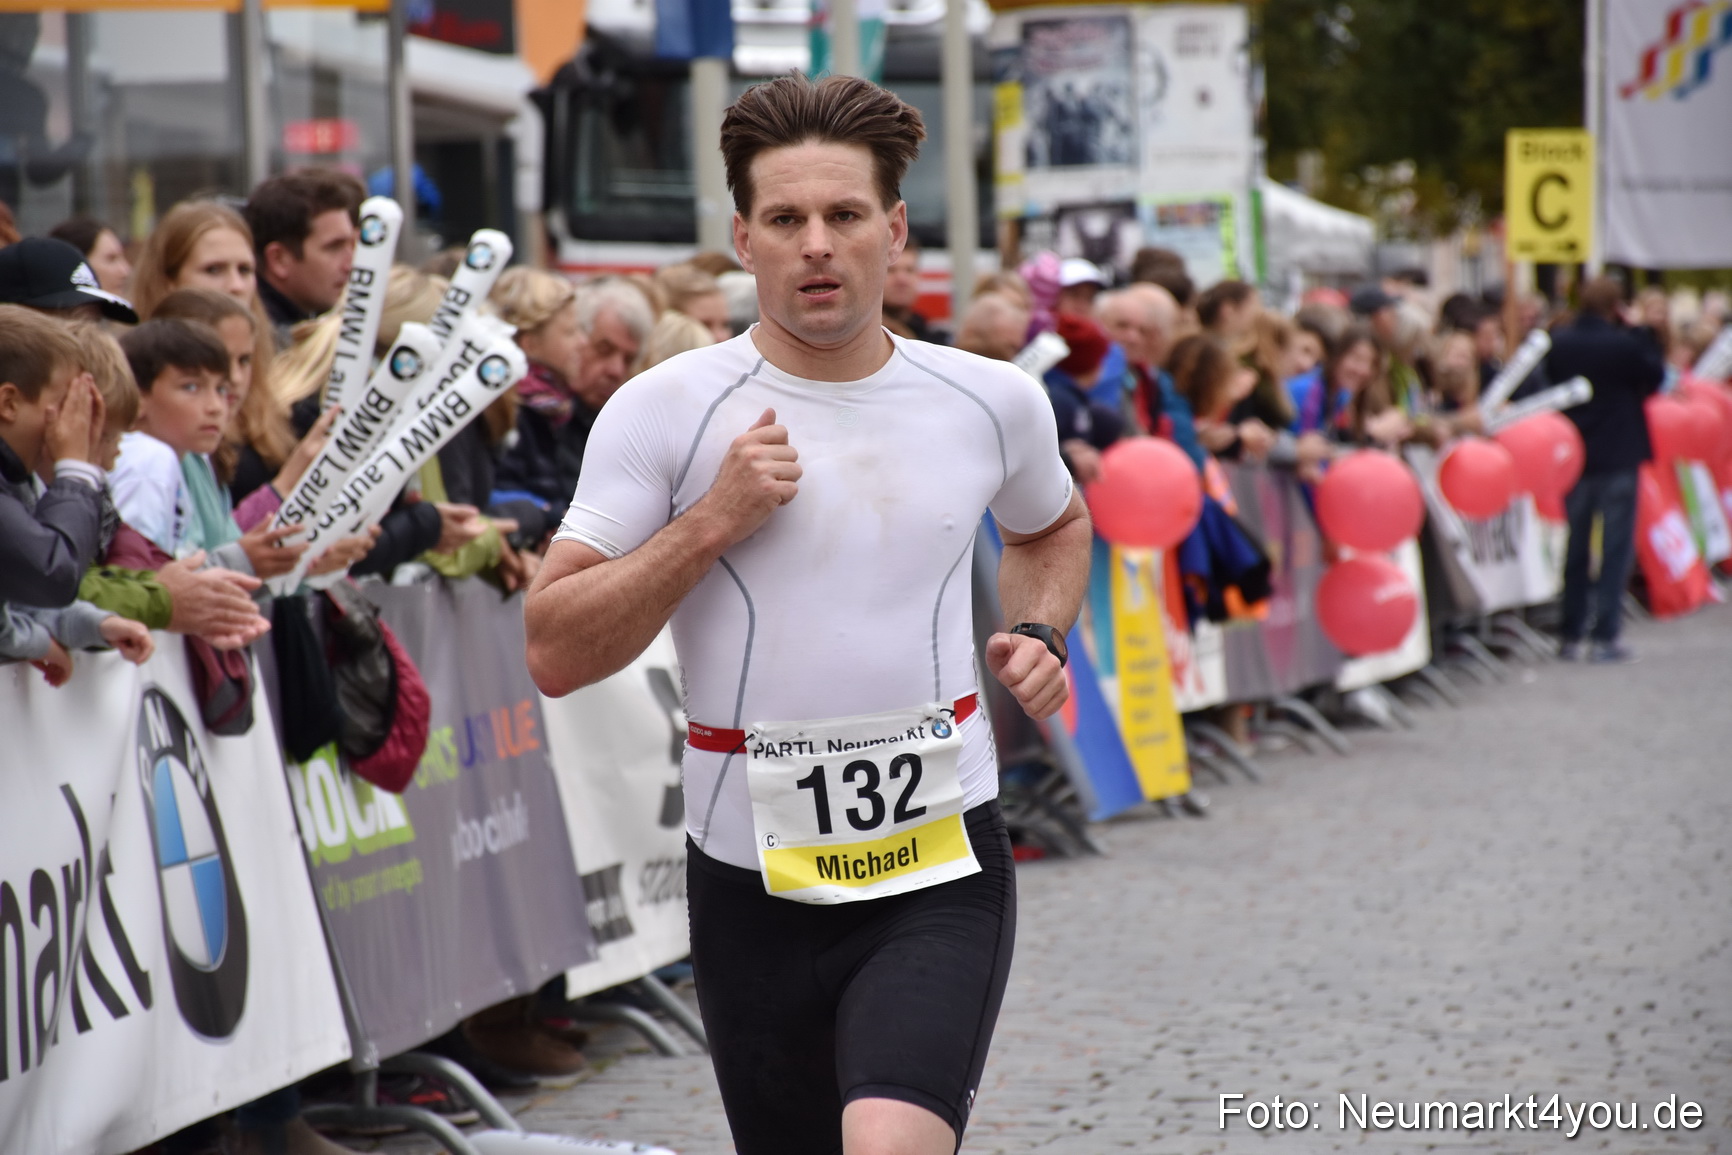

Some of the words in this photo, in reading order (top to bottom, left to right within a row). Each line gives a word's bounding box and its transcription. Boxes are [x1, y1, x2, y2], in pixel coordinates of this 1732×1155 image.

[1529, 170, 1572, 232] C
[339, 267, 375, 346] BMW
[335, 387, 394, 461] BMW
[400, 391, 472, 462] BMW
[753, 740, 822, 759] PARTL
[796, 752, 927, 835] 132
[766, 835, 775, 847] C
[816, 837, 919, 881] Michael
